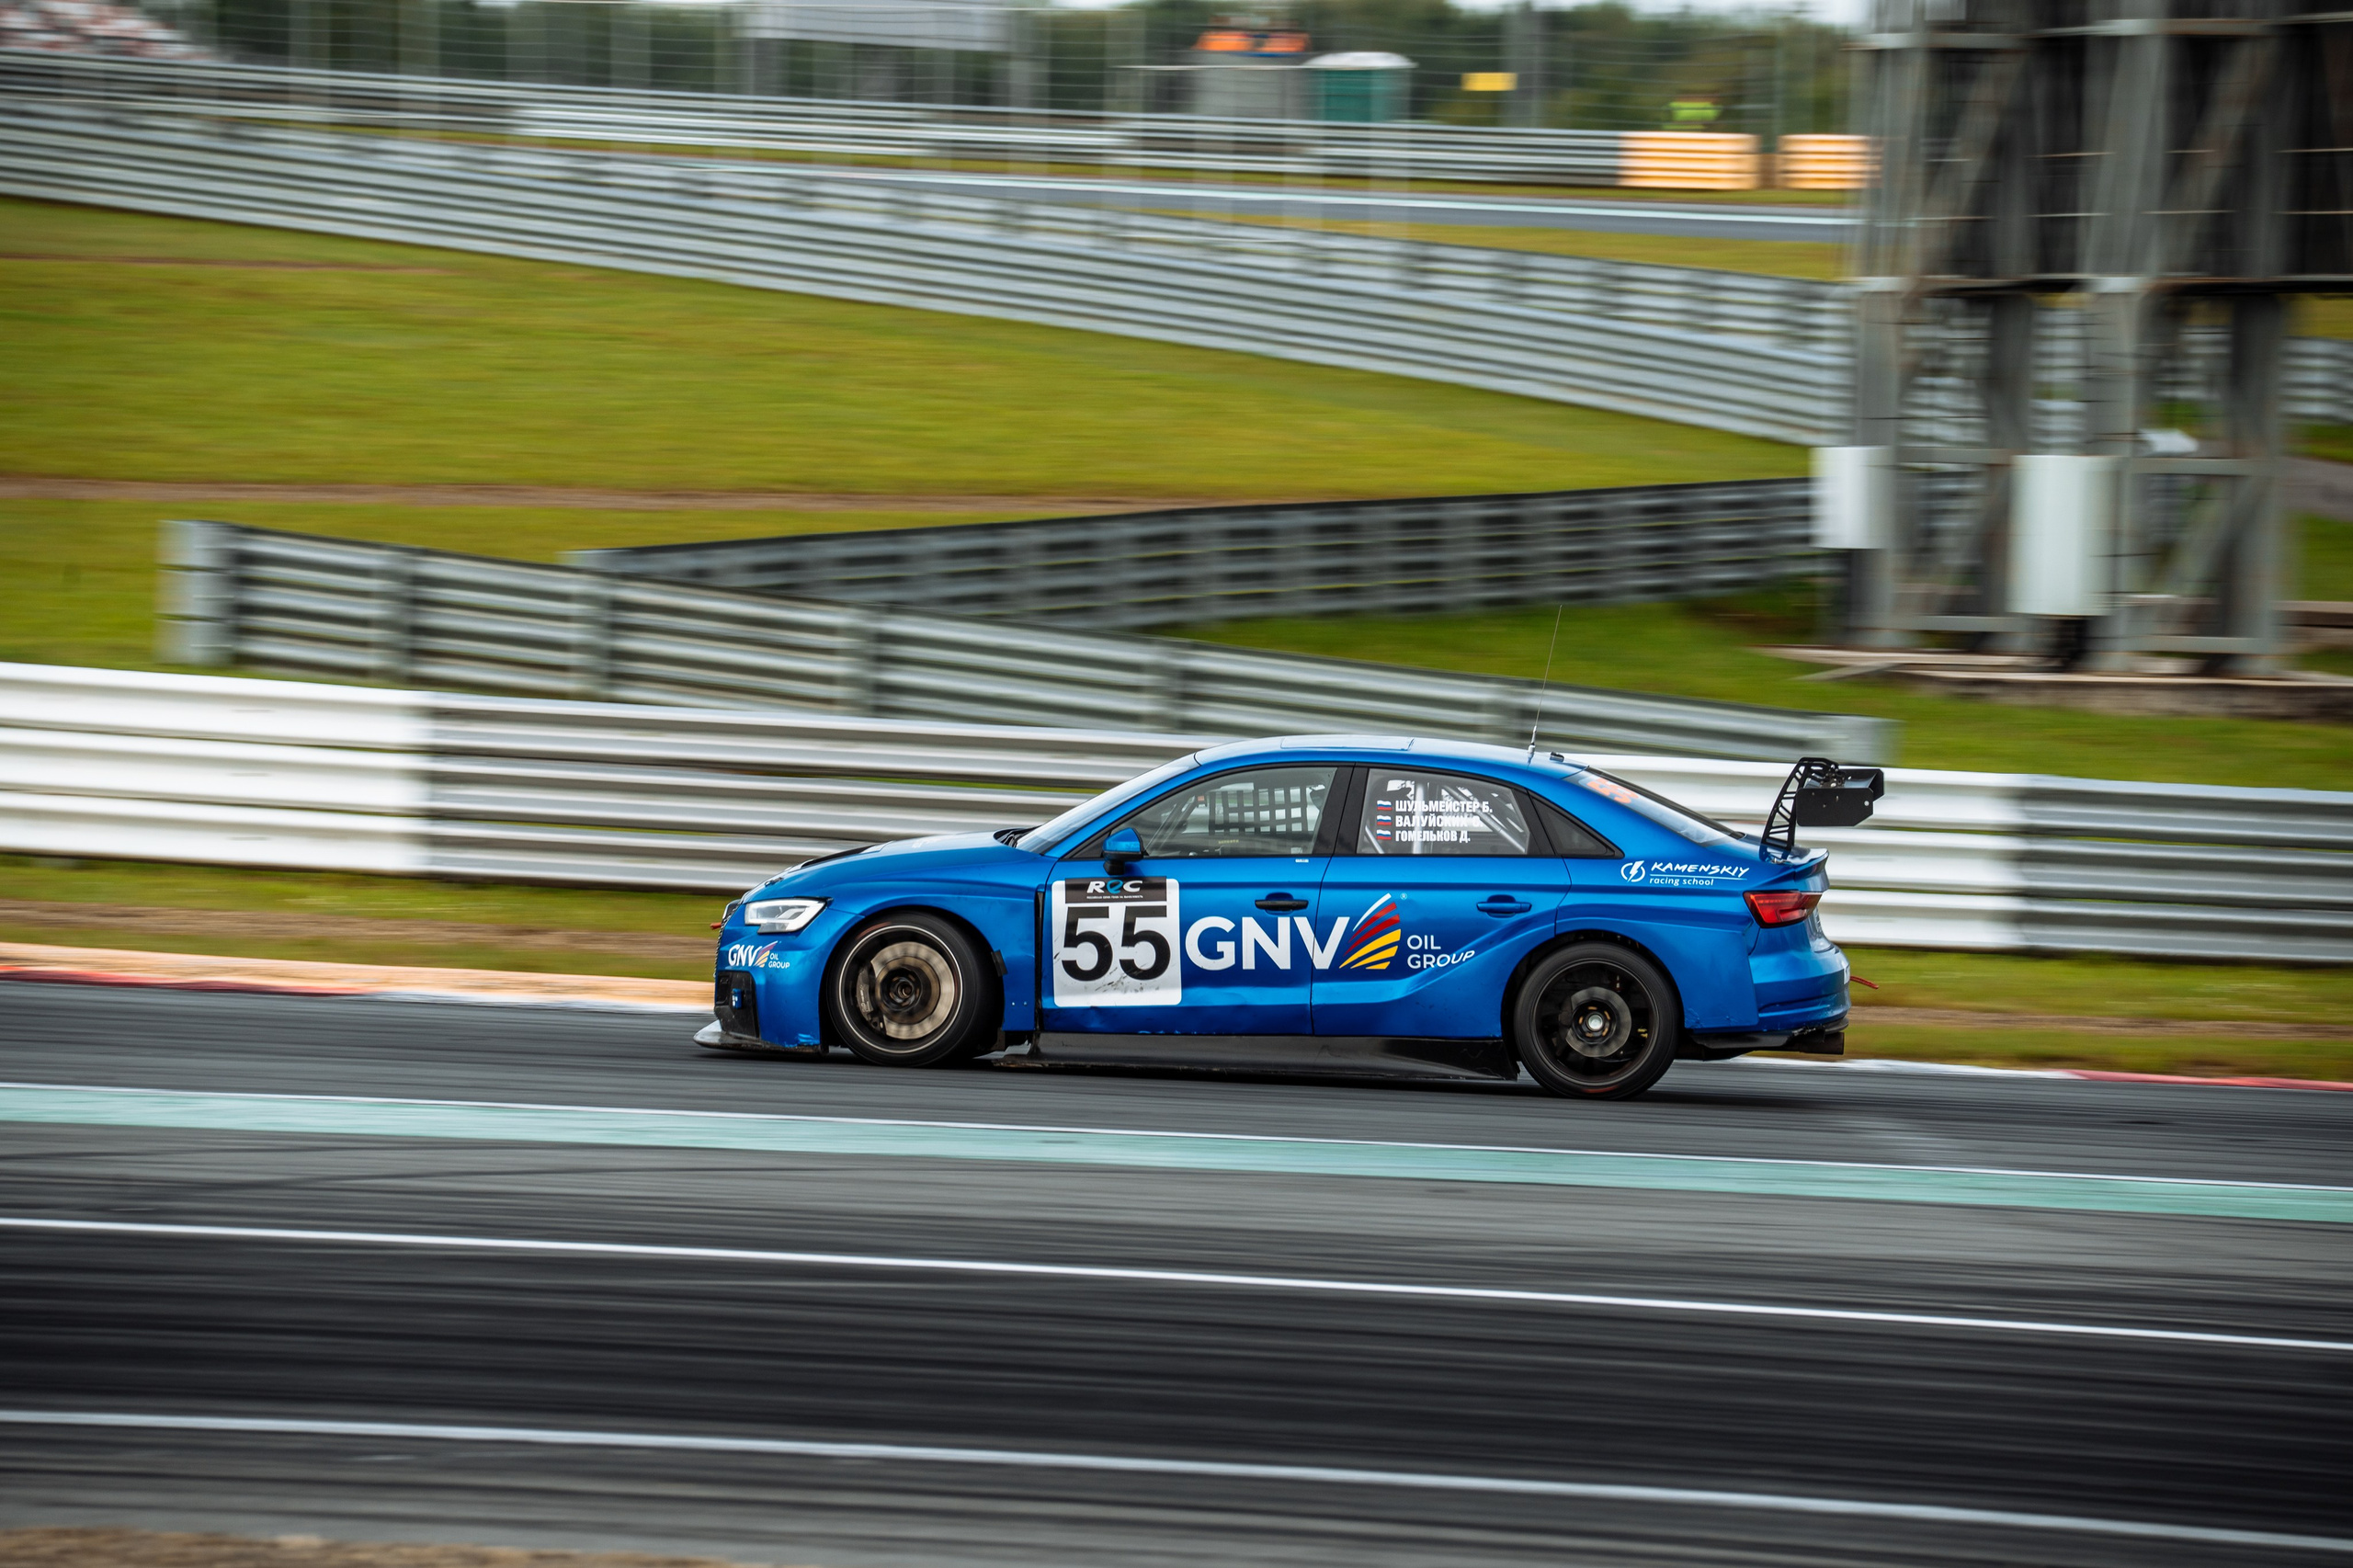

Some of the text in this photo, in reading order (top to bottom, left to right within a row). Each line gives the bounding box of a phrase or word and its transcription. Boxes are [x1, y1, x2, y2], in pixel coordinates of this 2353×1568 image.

[1395, 800, 1493, 813] ШУЛЬМЕЙСТЕР Б.
[1395, 830, 1471, 844] ГОМЕЛЬКОВ Д.
[1651, 862, 1750, 878] KAMENSKIY
[1649, 877, 1714, 887] racing school
[1062, 905, 1171, 982] 55
[1185, 915, 1350, 971] GNV
[1406, 934, 1441, 950] OIL
[728, 944, 762, 967] GNV
[769, 952, 779, 960] OIL
[1406, 950, 1475, 970] GROUP
[767, 960, 790, 969] GROUP
